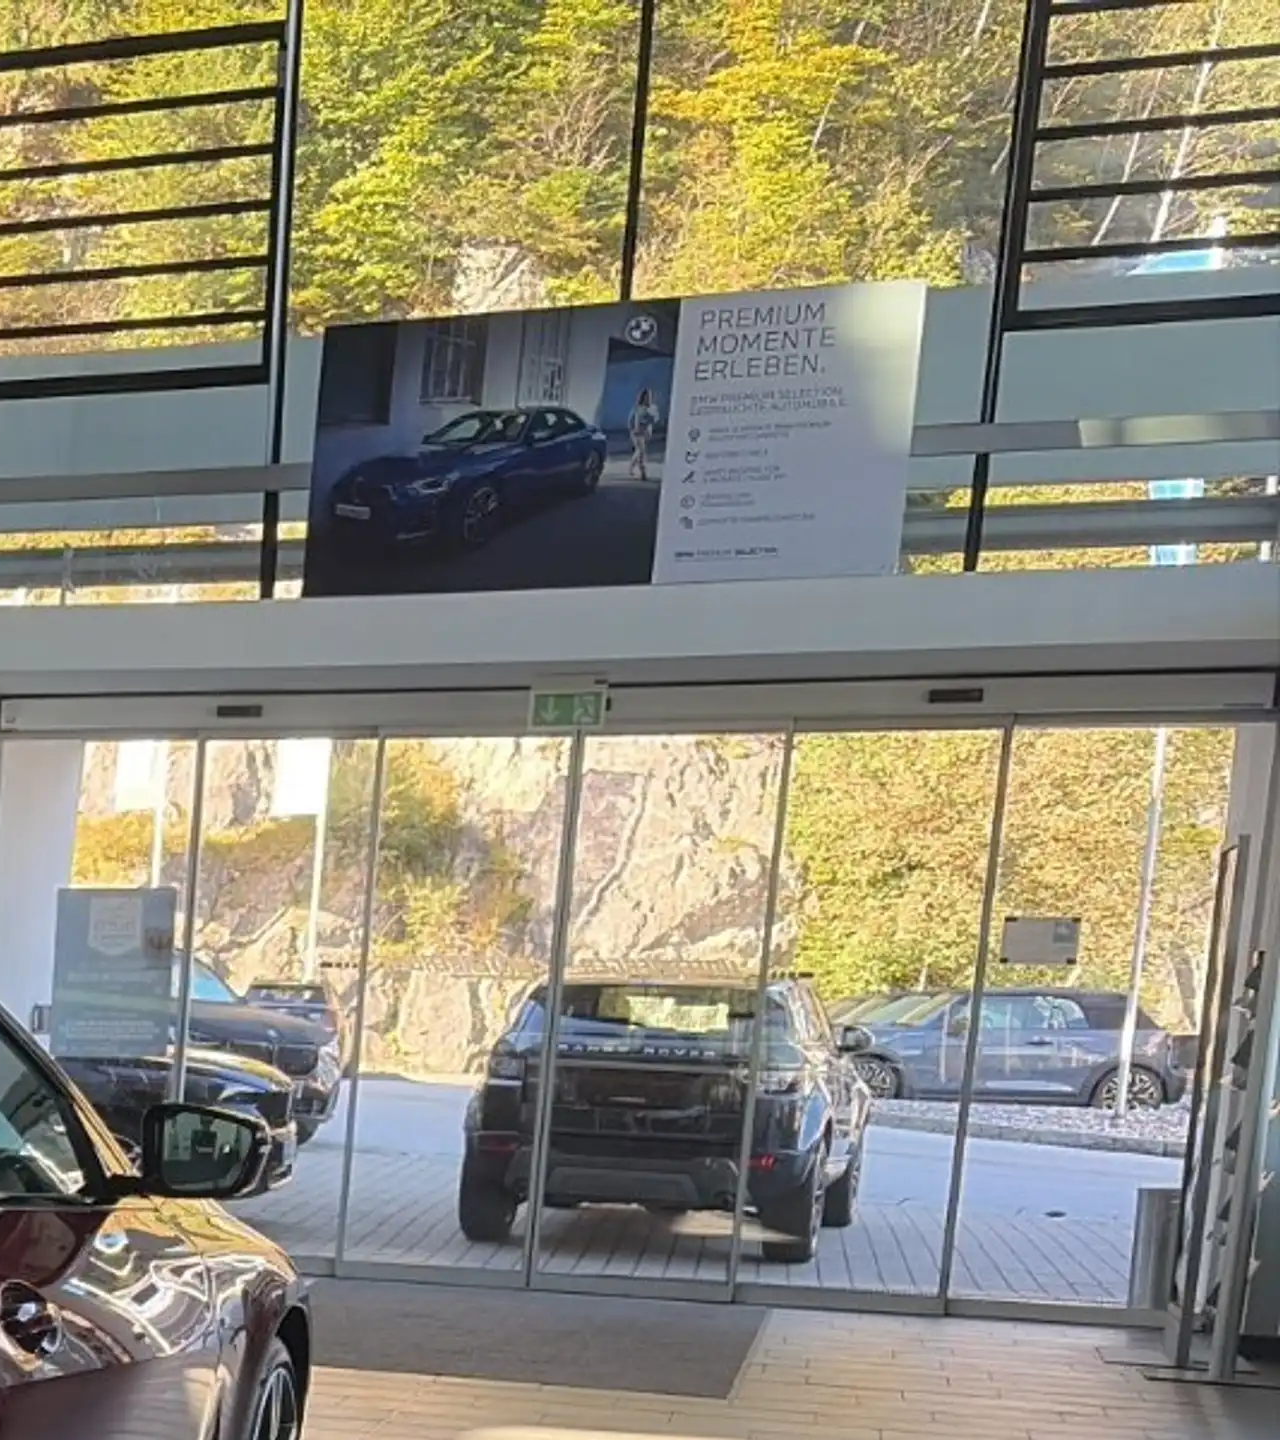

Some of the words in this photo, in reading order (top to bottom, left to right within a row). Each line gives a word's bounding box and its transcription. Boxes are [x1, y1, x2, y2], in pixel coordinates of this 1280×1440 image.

[700, 302, 826, 330] PREMIUM
[696, 326, 837, 357] MOMENTE
[693, 354, 827, 382] ERLEBEN.
